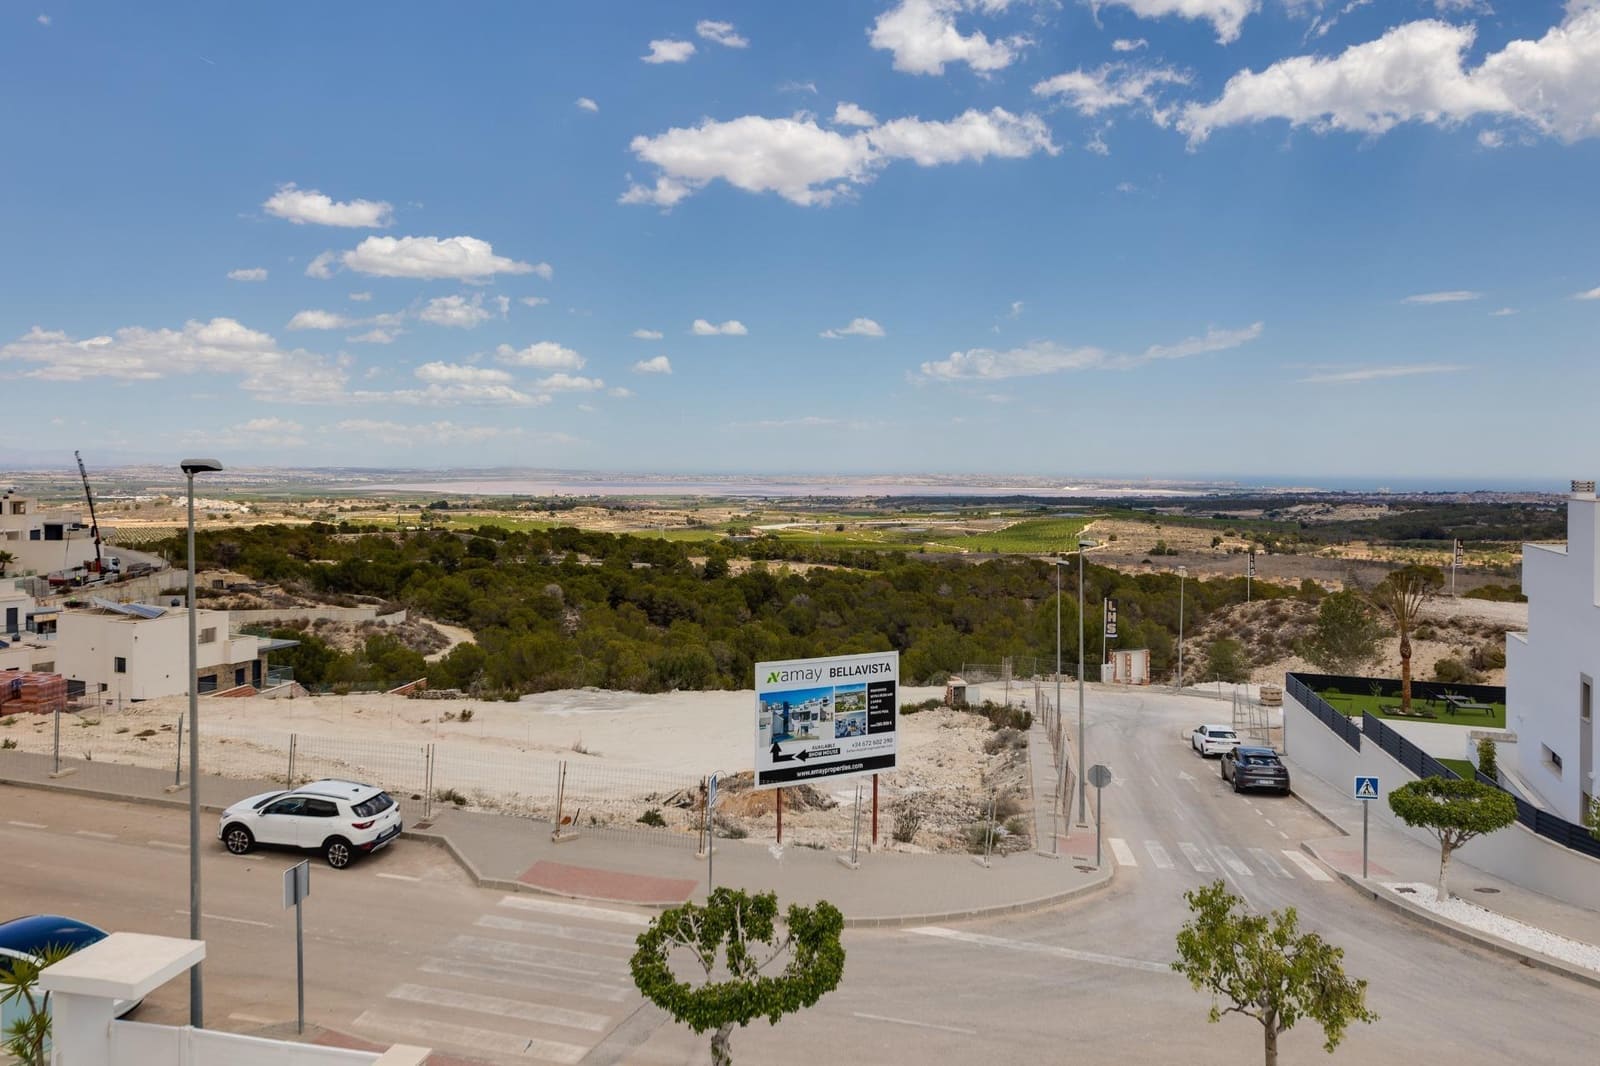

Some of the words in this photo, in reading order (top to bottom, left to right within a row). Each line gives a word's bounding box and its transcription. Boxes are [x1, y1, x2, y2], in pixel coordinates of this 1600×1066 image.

[1107, 600, 1116, 634] LHS
[829, 662, 892, 678] BELLAVISTA
[796, 763, 864, 777] www.amayproperties.com
